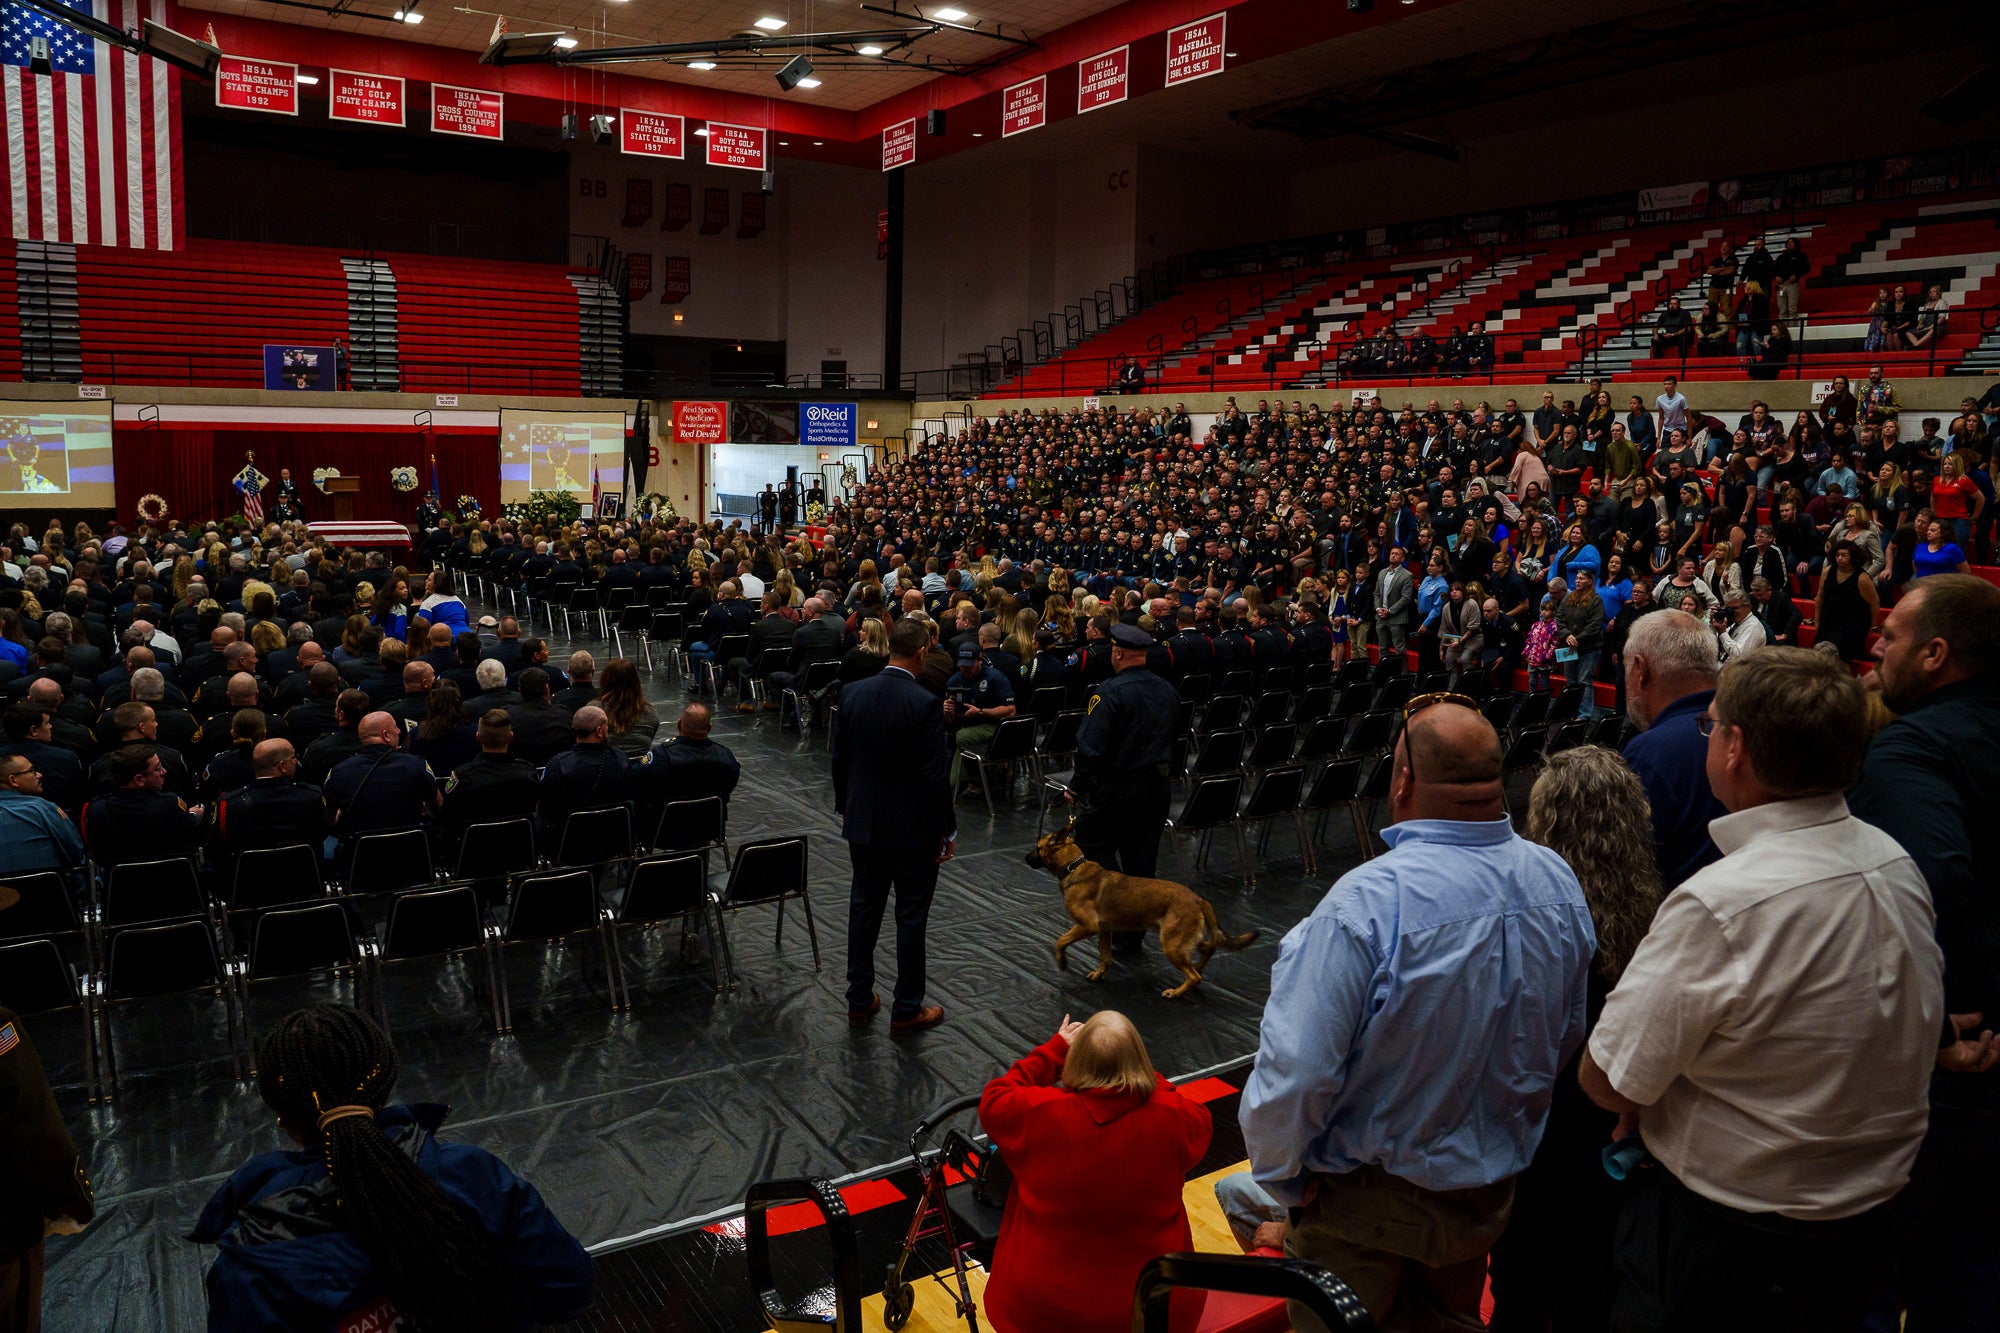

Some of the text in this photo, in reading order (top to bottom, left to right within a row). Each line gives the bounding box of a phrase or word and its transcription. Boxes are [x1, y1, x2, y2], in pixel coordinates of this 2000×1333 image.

[1185, 25, 1207, 40] IHSAA
[1179, 36, 1212, 54] BASEBALL
[1170, 44, 1221, 68] STATE FINALIST
[242, 64, 273, 76] IHSAA
[1094, 58, 1113, 71] IHSAA
[220, 71, 294, 88] BOYS BASKETBALL
[1088, 66, 1118, 83] BOYS GOLF
[226, 82, 289, 97] STATE CHAMPS
[354, 78, 382, 89] IHSAA
[1081, 73, 1125, 95] STATE RUNNER-UP
[341, 86, 392, 100] BOYS GOLF
[454, 91, 480, 101] IHSAA
[1096, 90, 1110, 101] 1973
[247, 95, 269, 105] 1992
[336, 95, 396, 110] STATE CHAMPS
[457, 100, 477, 109] BOYS
[357, 108, 378, 118] 1993
[437, 105, 498, 120] CROSS COUNTRY
[439, 113, 496, 127] STATE CHAMPS
[640, 116, 665, 127] IHSAA
[459, 123, 476, 133] 1994
[635, 124, 669, 135] BOYS GOLF
[725, 129, 748, 139] IHSAA
[630, 132, 676, 144] STATE CHAMPS
[719, 137, 755, 148] BOYS GOLF
[644, 143, 661, 151] 1997
[712, 144, 761, 157] STATE CHAMPS
[728, 155, 745, 163] 2003
[1108, 169, 1129, 191] CC
[580, 179, 607, 198] BB
[683, 405, 718, 415] Reid Sports
[821, 407, 847, 420] Reid
[809, 420, 841, 428] Orthopedics
[680, 430, 720, 438] Red Devils!
[807, 435, 849, 444] ReidOrtho.org
